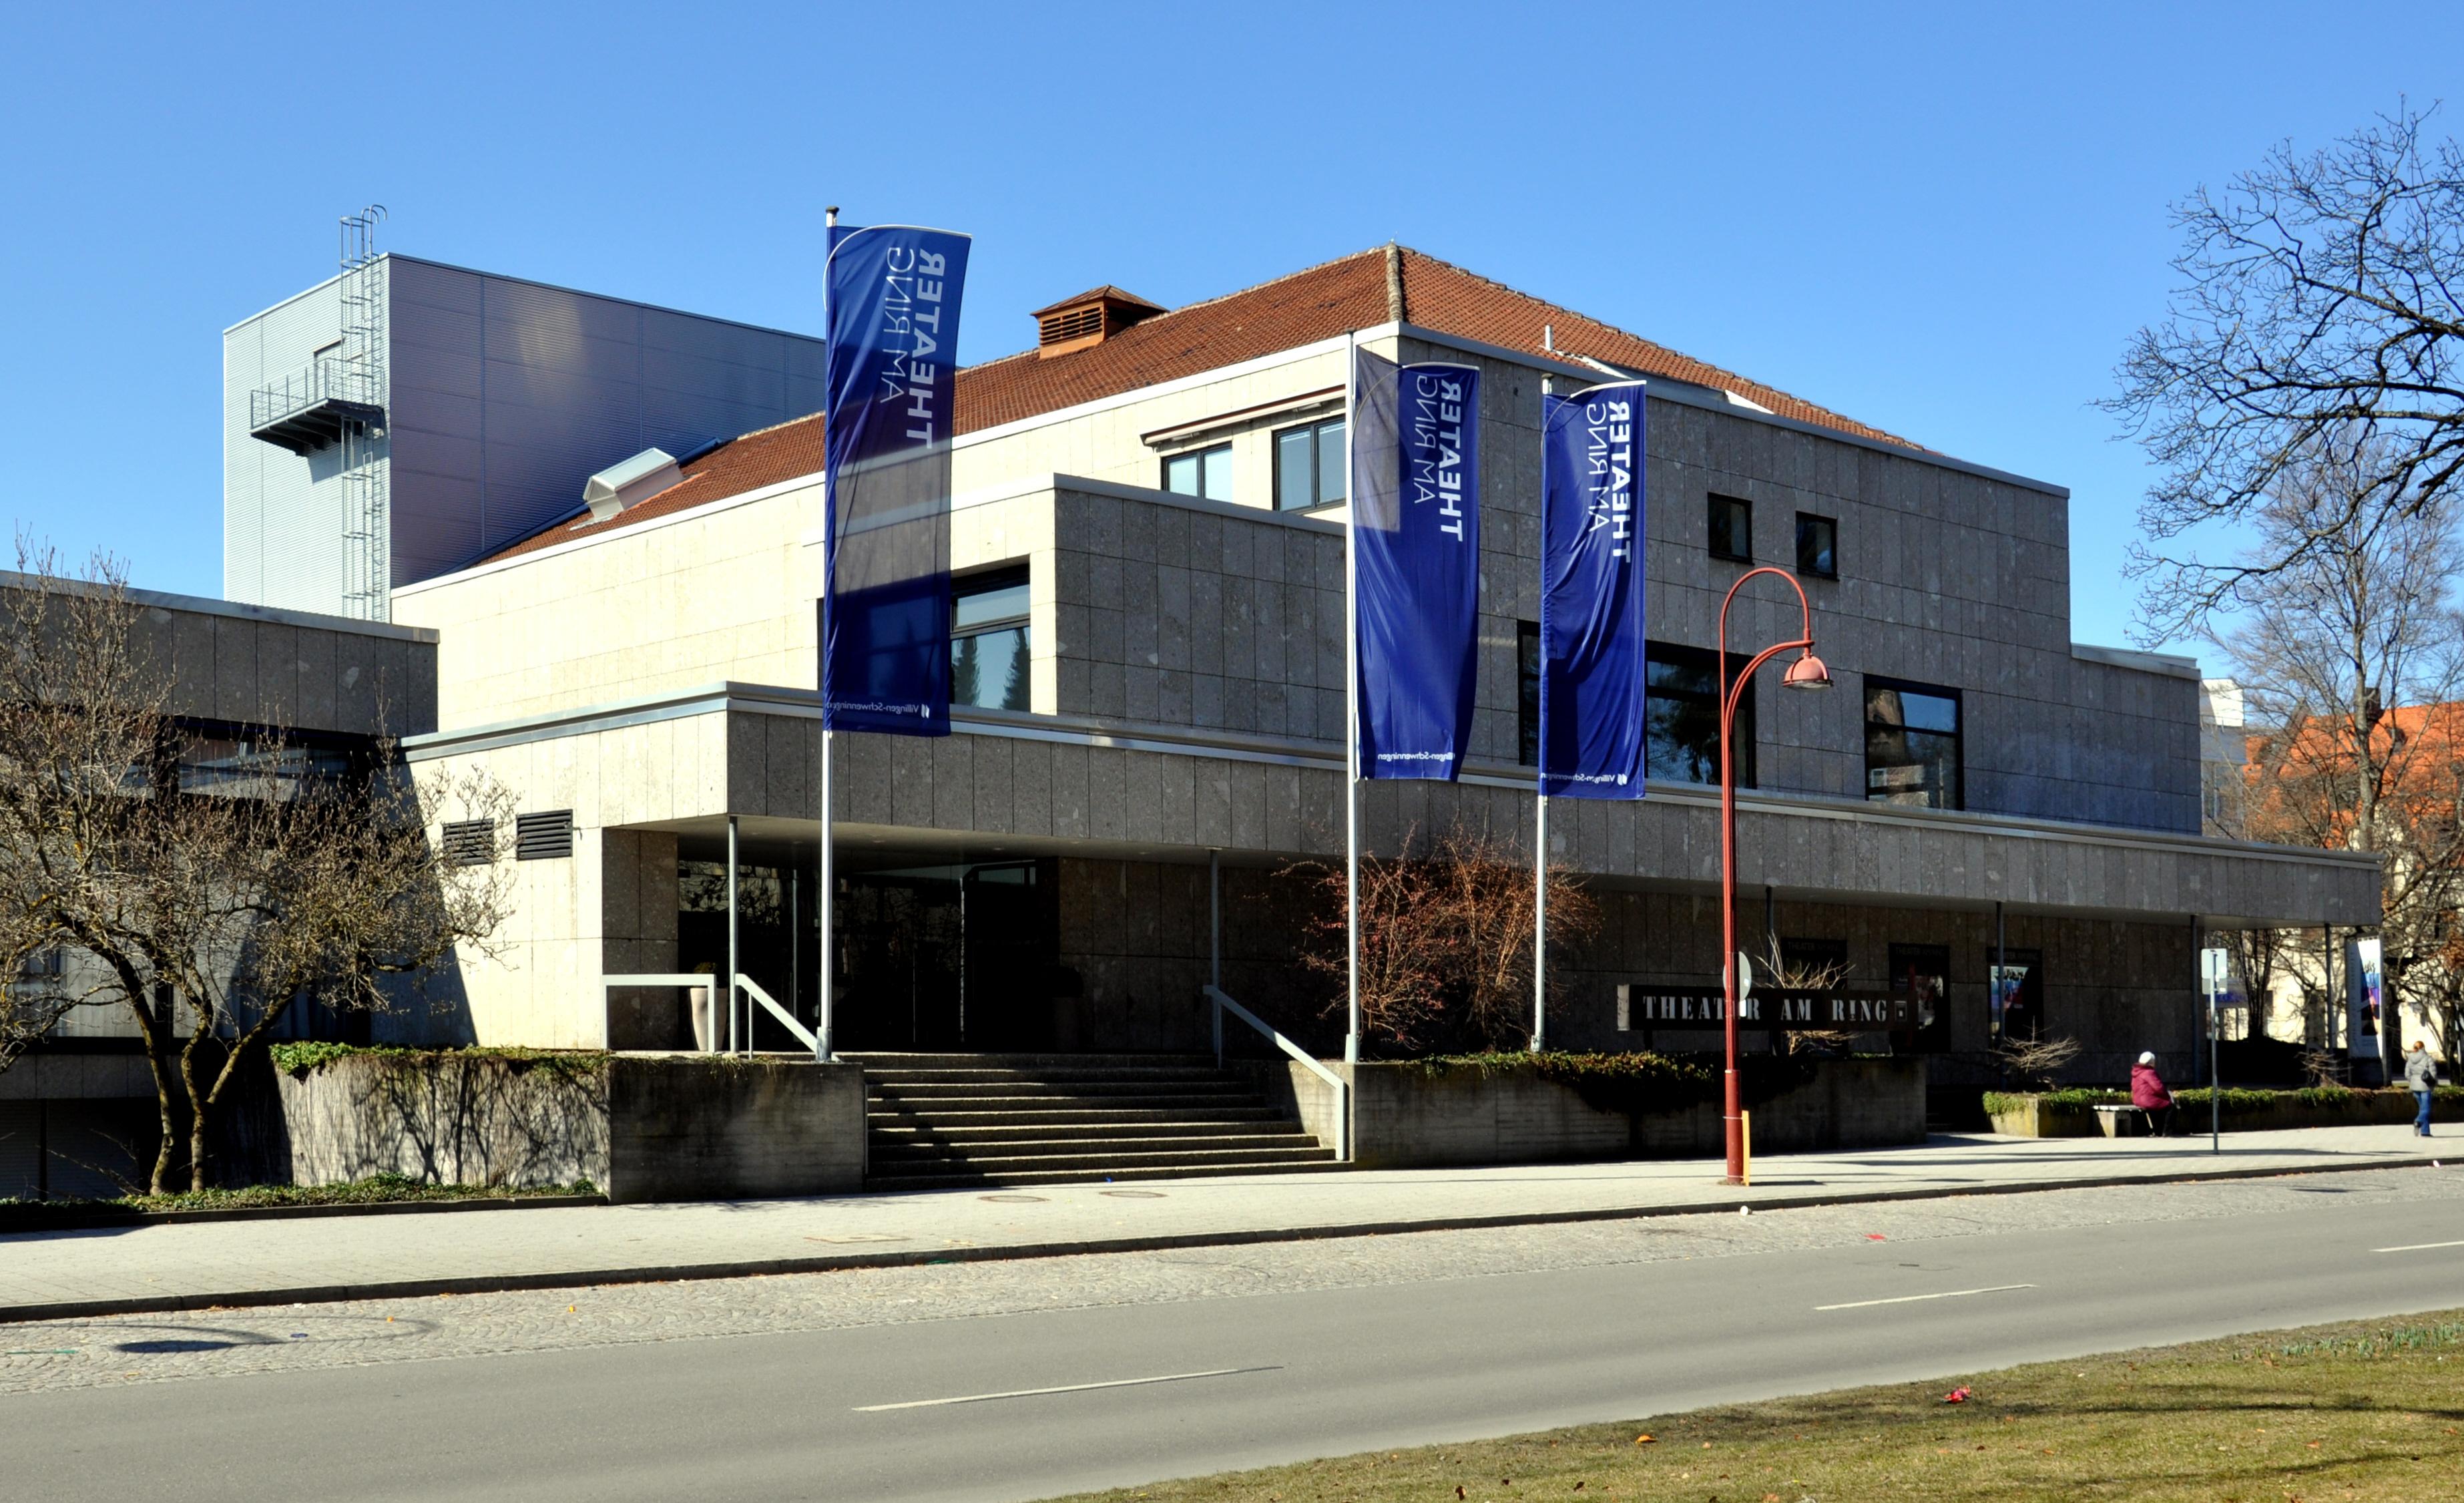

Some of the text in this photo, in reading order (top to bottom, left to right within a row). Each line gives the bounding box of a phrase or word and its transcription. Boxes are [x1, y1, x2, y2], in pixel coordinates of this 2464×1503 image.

[1643, 996, 1887, 1022] THEATR AM RING
